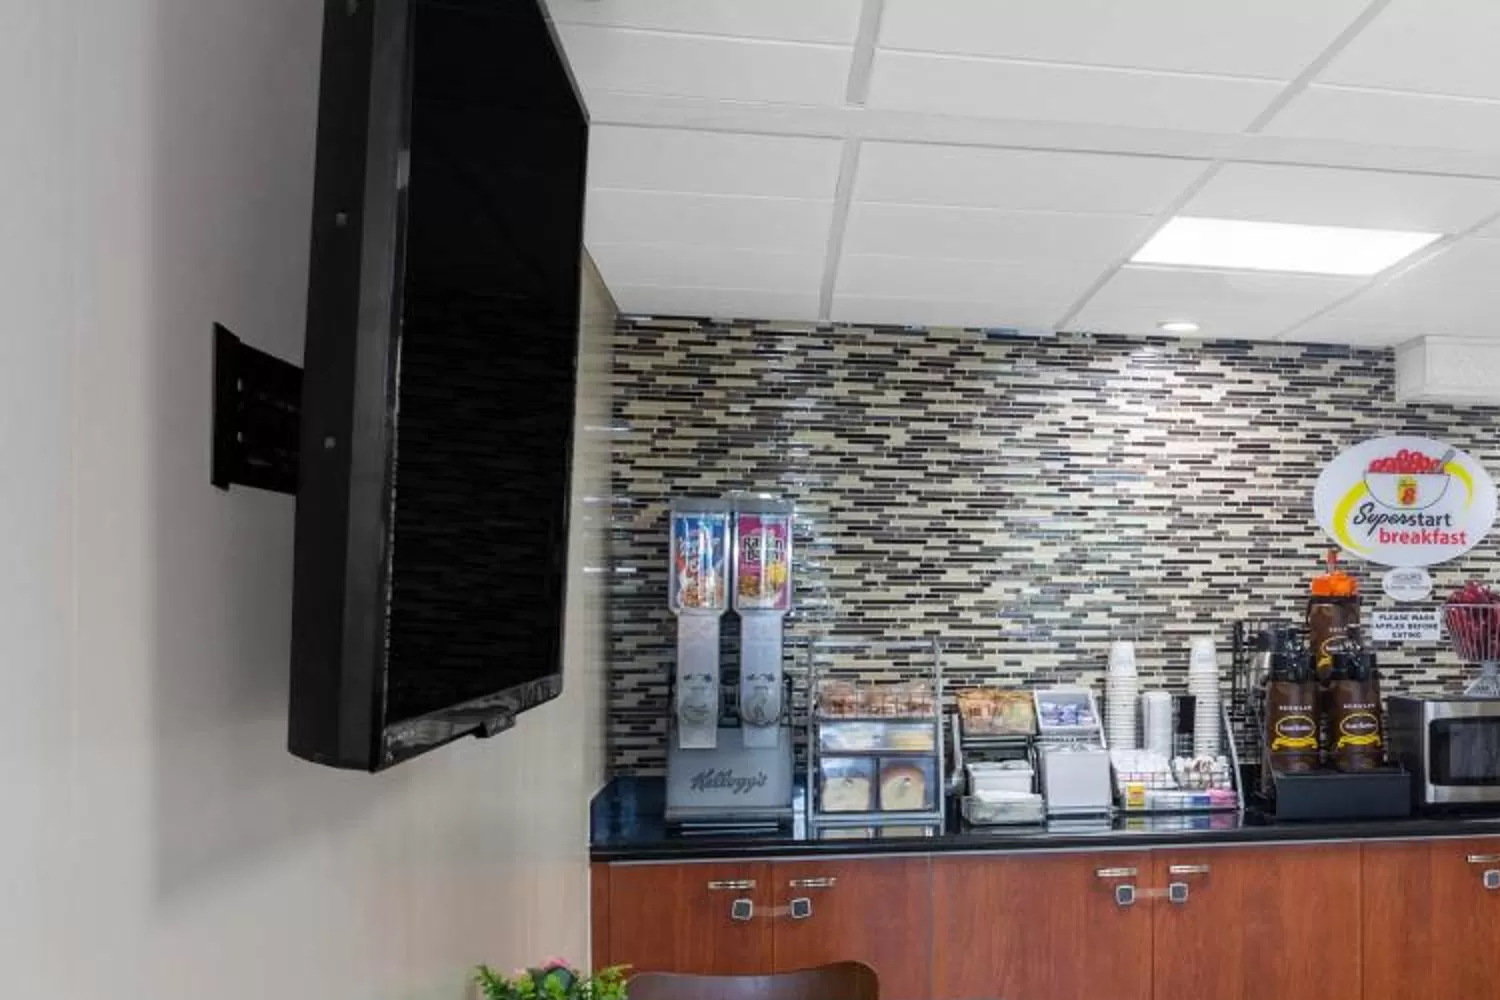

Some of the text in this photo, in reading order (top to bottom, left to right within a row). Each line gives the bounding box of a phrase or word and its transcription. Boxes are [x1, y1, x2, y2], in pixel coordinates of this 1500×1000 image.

[1353, 502, 1451, 536] Superstart
[1379, 528, 1467, 545] breakfast
[689, 767, 768, 795] Kellogg's
